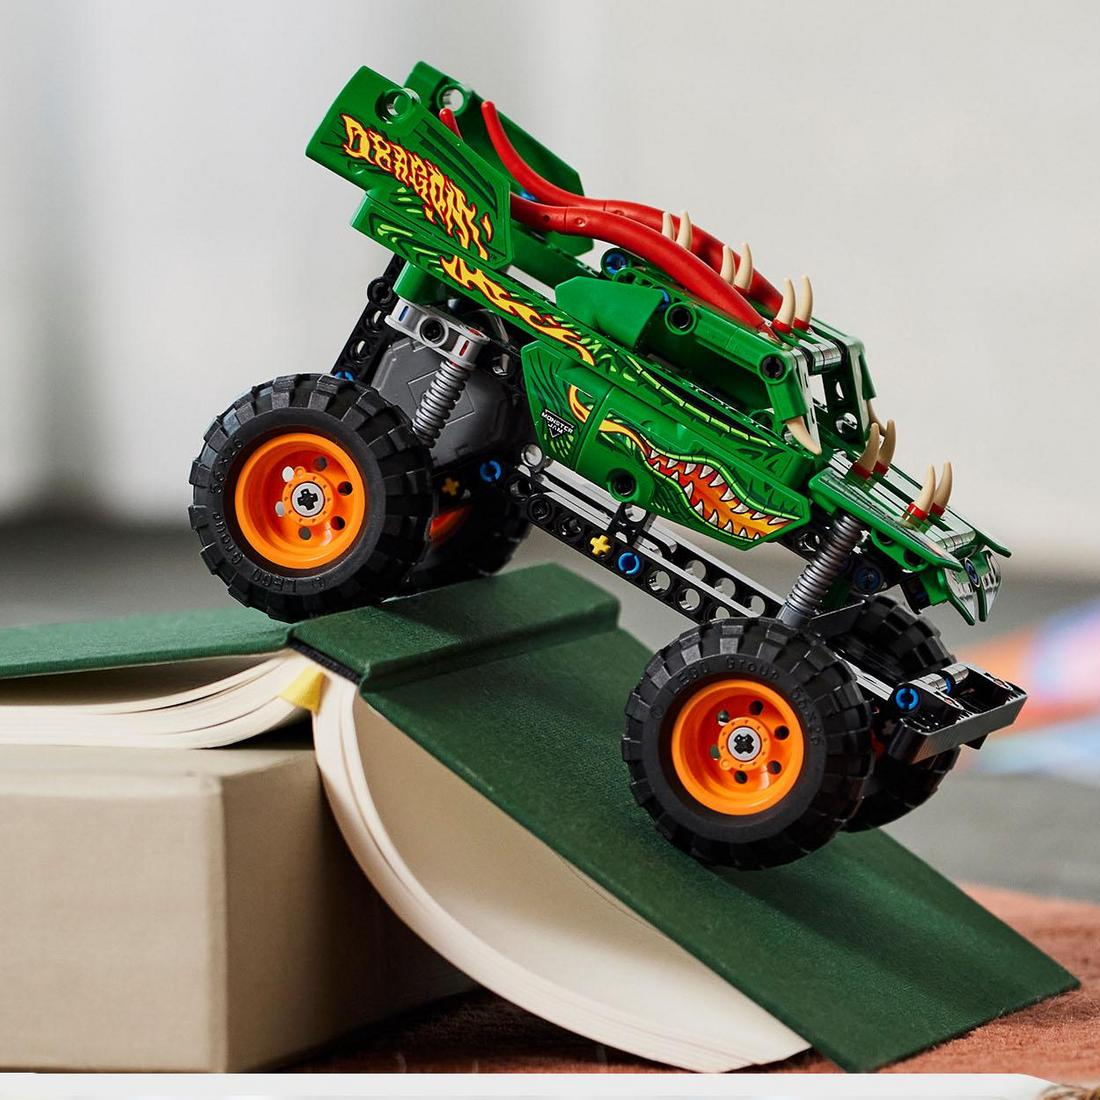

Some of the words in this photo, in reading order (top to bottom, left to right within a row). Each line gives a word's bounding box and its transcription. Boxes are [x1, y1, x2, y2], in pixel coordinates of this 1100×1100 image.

[341, 113, 490, 261] DRAGON
[541, 411, 574, 434] MONSTER
[547, 423, 564, 434] JAM
